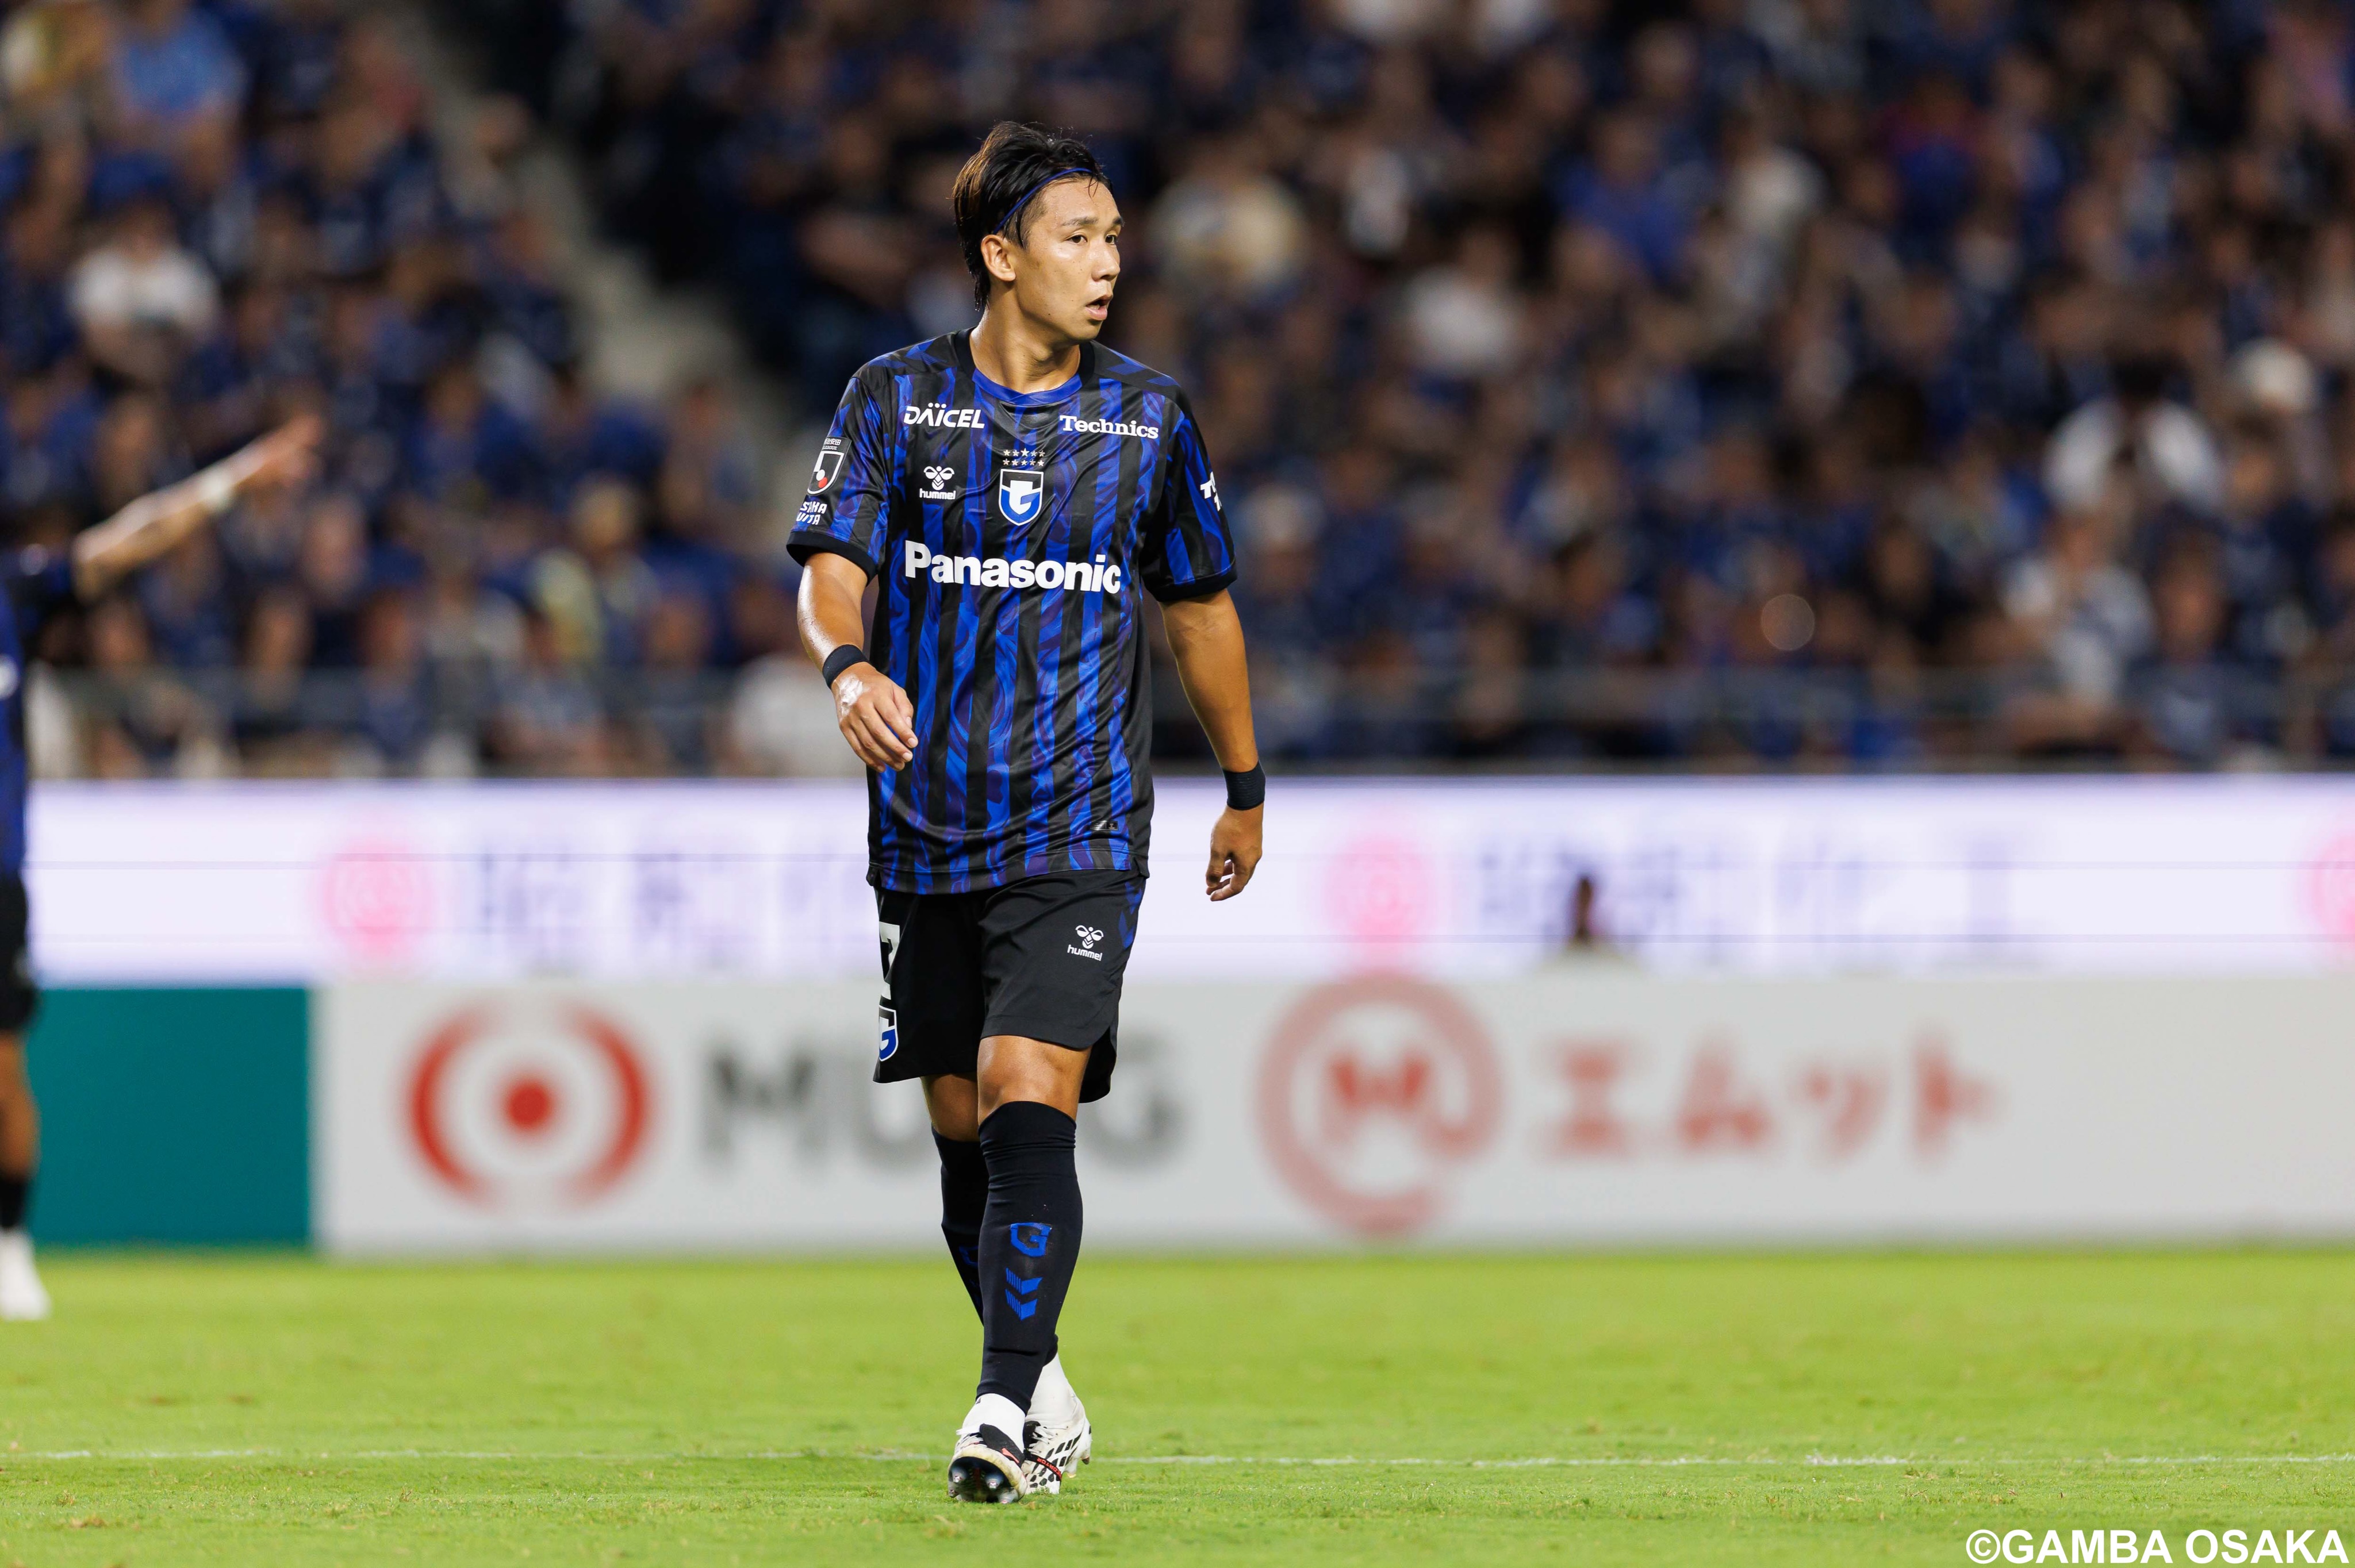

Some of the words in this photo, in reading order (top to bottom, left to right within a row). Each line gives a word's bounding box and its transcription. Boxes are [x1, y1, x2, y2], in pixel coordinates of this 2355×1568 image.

[1060, 415, 1159, 439] Technics
[919, 488, 956, 499] hummel
[906, 540, 1121, 594] Panasonic
[1067, 944, 1103, 962] hummel
[699, 1033, 1190, 1171] MUG
